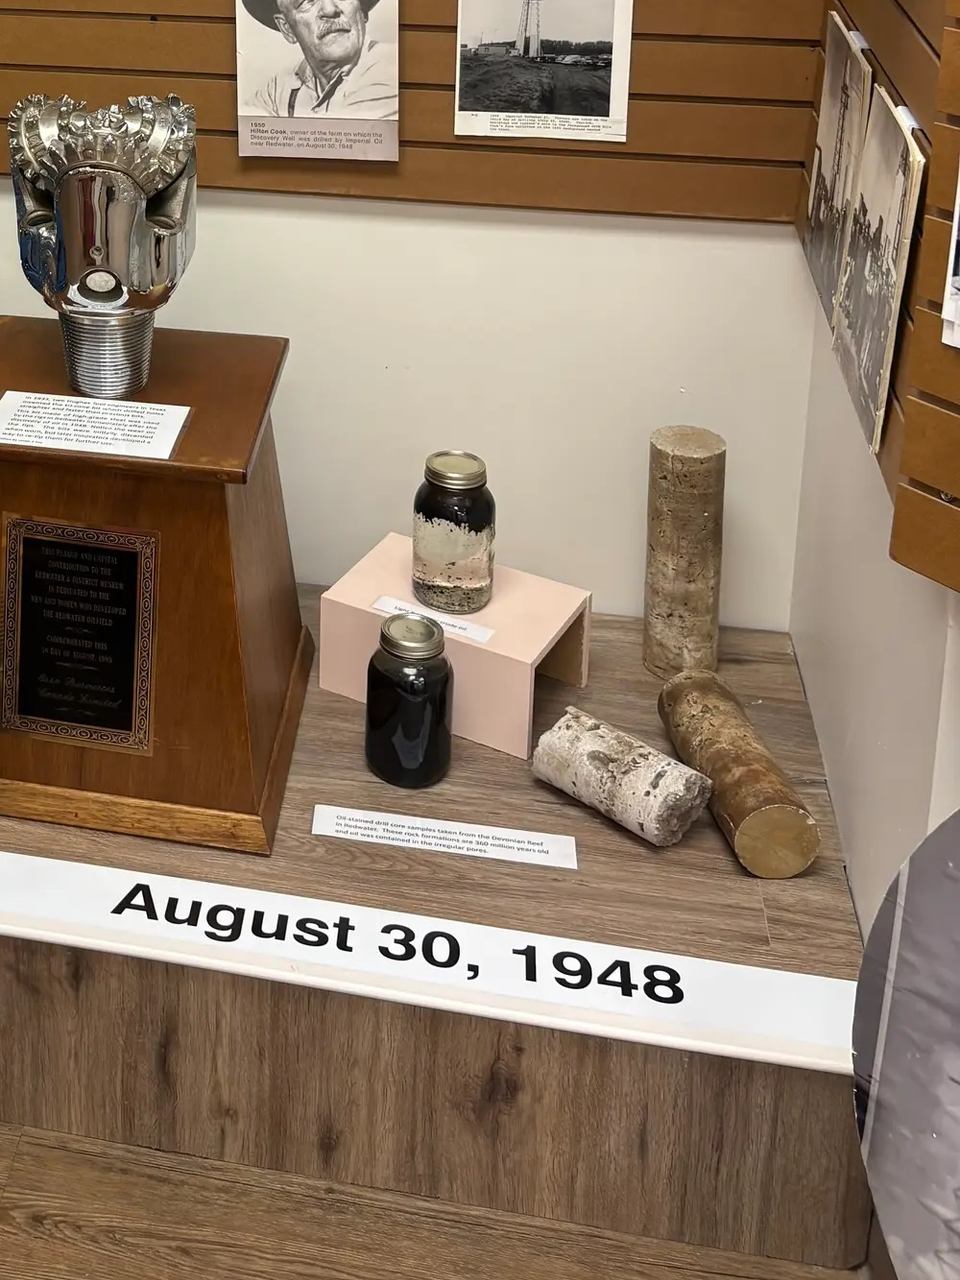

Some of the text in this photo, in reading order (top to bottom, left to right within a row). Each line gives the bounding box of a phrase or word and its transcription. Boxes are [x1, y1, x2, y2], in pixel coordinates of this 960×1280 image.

[375, 834, 411, 843] contained
[434, 842, 465, 851] irregular
[407, 825, 436, 834] samples
[491, 836, 526, 845] Devonian
[421, 833, 460, 843] formations
[490, 842, 515, 850] million
[111, 883, 684, 1004] August 30, 1948
